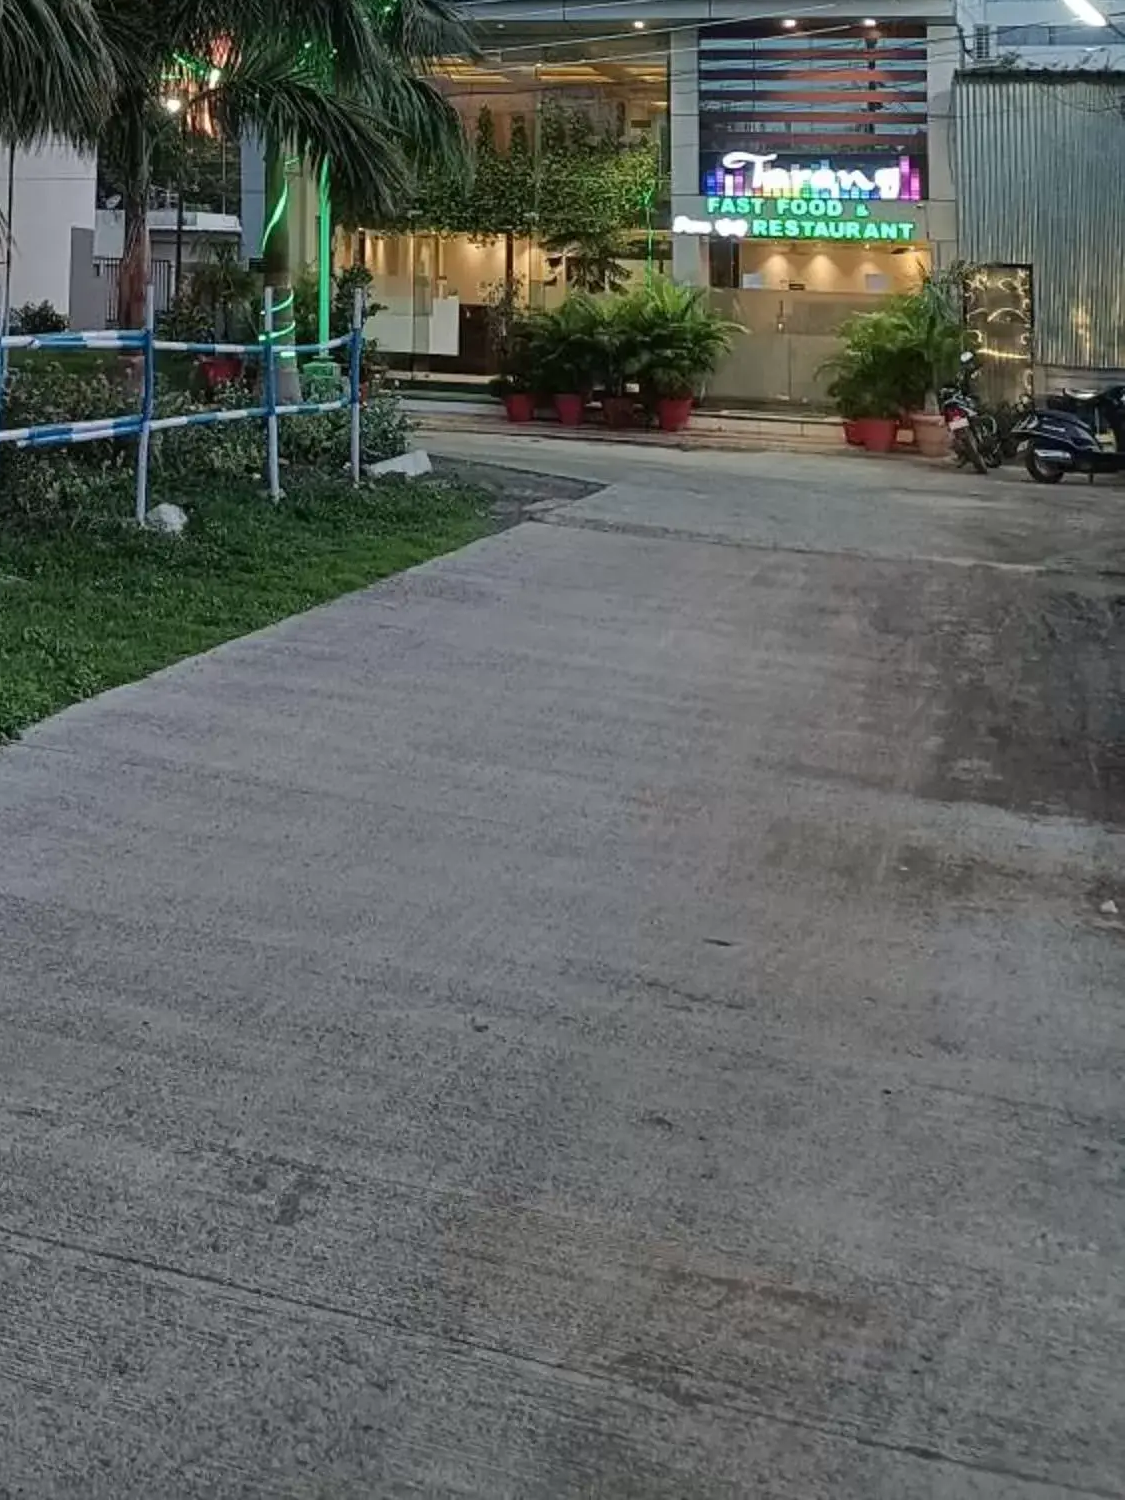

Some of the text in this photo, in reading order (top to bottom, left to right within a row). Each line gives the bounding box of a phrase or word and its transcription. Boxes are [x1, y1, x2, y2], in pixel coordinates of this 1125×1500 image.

[706, 198, 766, 216] FAST
[776, 199, 843, 218] FOOD
[751, 219, 915, 241] RESTAURANT
